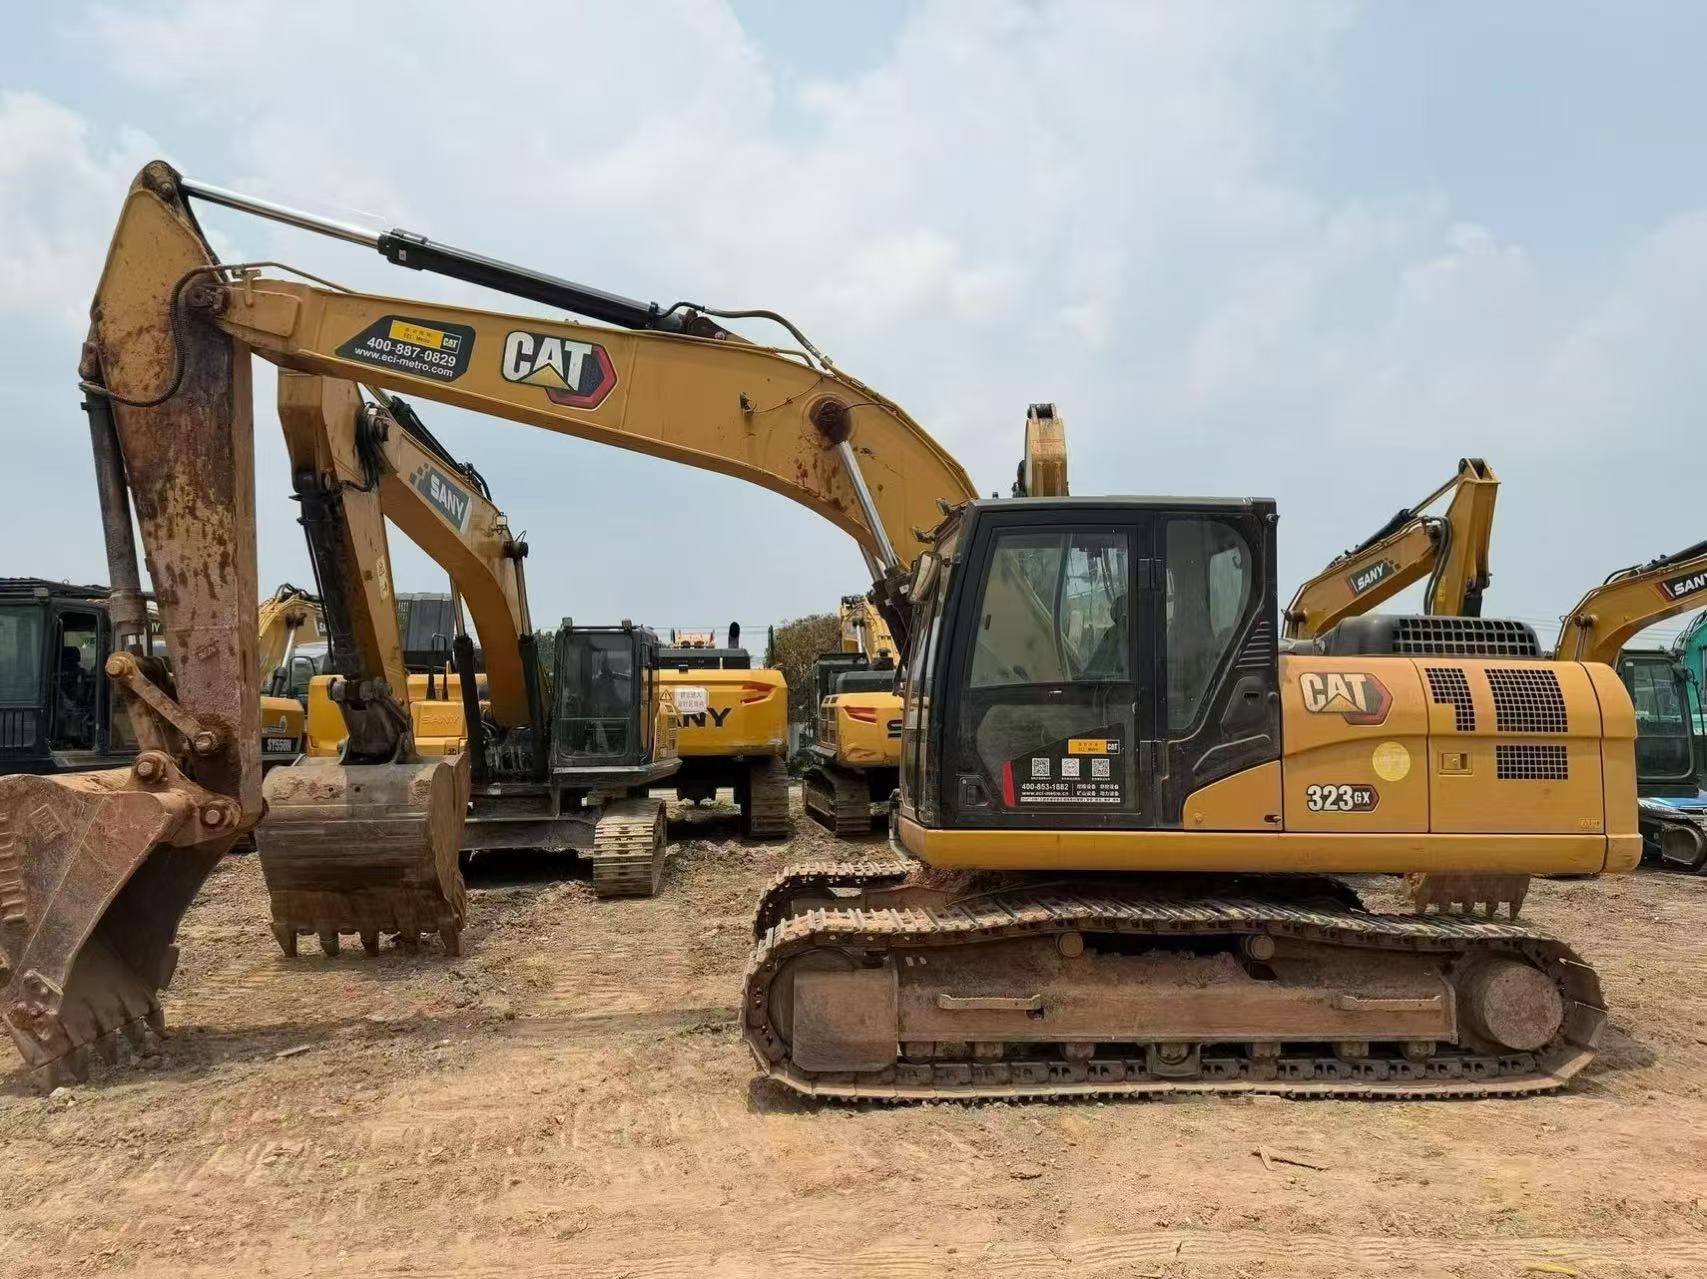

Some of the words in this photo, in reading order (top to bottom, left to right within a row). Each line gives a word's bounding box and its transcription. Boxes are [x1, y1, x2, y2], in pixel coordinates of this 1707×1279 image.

[367, 337, 456, 367] 400-887-0829
[443, 337, 459, 349] CAT
[354, 347, 454, 377] www.eci-metro.com
[503, 331, 593, 392] CAT
[430, 474, 464, 520] SANY
[1357, 562, 1384, 591] SANY
[1300, 673, 1367, 712] CAT
[1107, 743, 1118, 751] CAT
